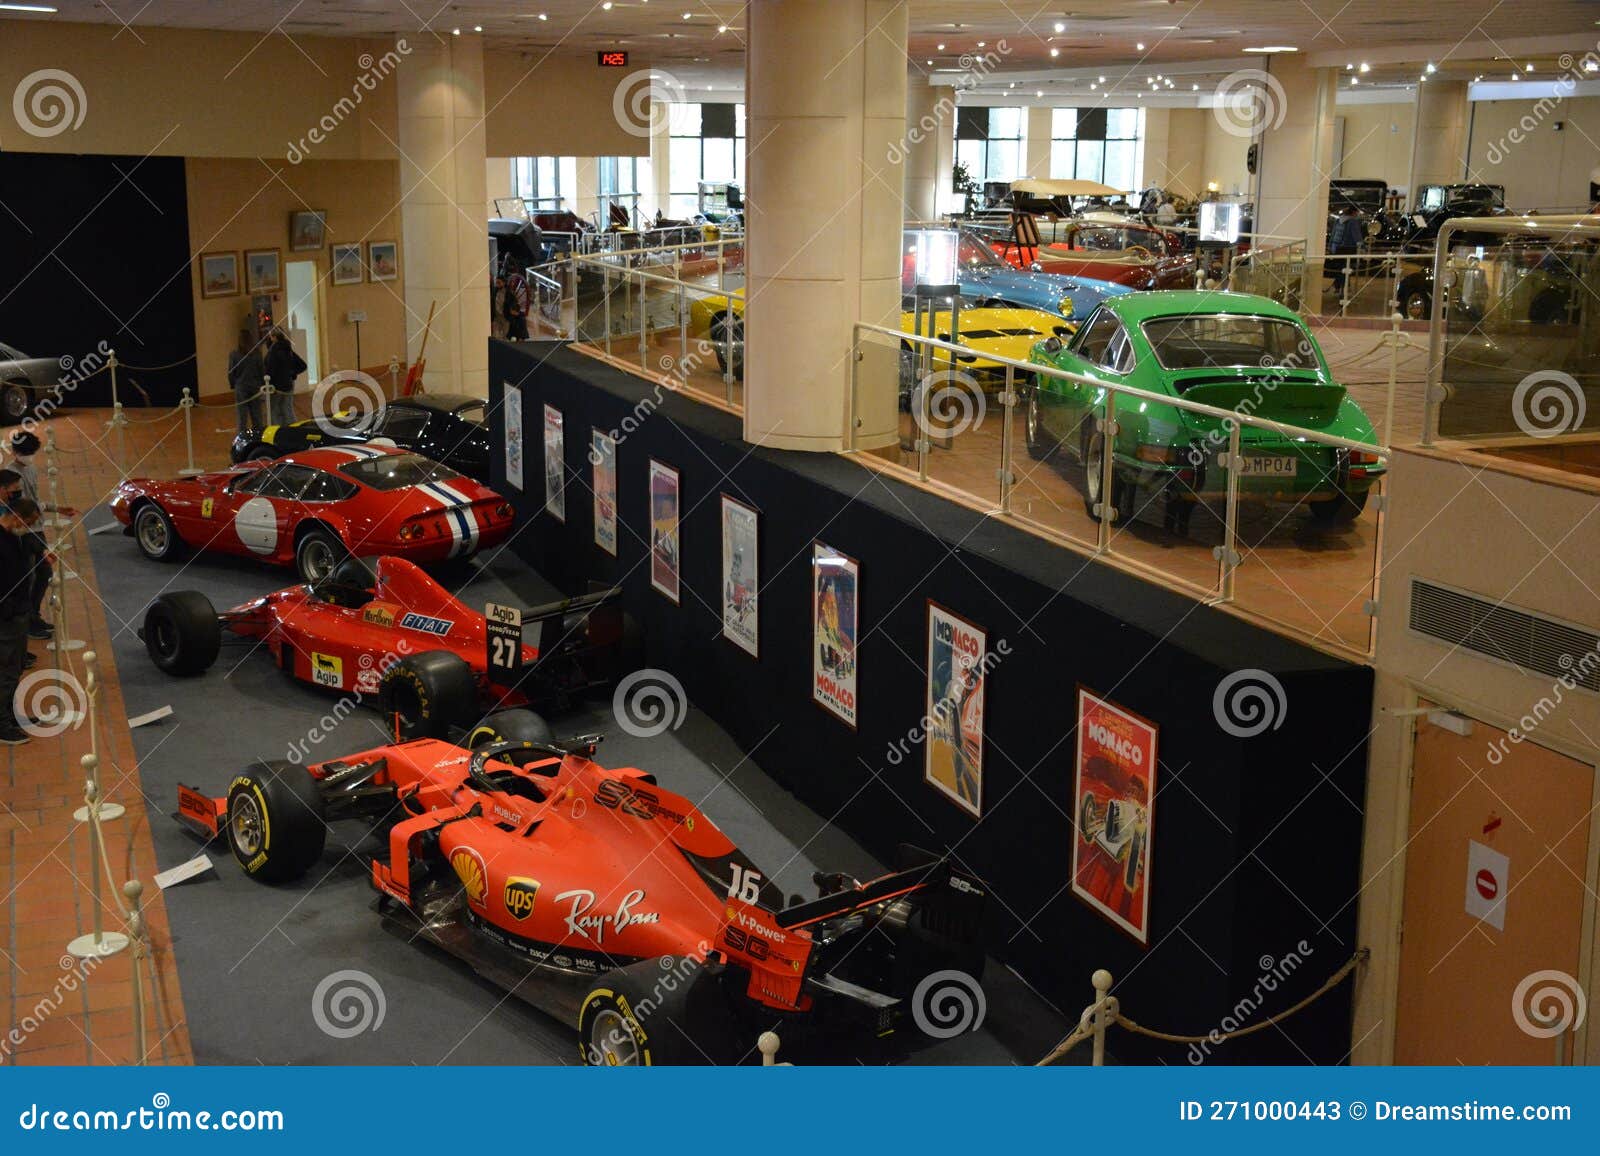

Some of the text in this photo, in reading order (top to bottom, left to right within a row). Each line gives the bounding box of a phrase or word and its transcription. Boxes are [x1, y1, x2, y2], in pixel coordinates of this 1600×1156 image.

[402, 614, 451, 635] FIAT
[492, 605, 515, 622] Agip
[492, 636, 516, 669] 27
[936, 618, 979, 658] MONACO
[316, 669, 339, 686] Agip
[816, 671, 854, 710] MONACO
[1089, 719, 1143, 766] MONACO
[494, 804, 522, 825] HUBLOT
[727, 862, 761, 906] 16
[506, 888, 533, 914] ups
[737, 912, 787, 943] V-Power
